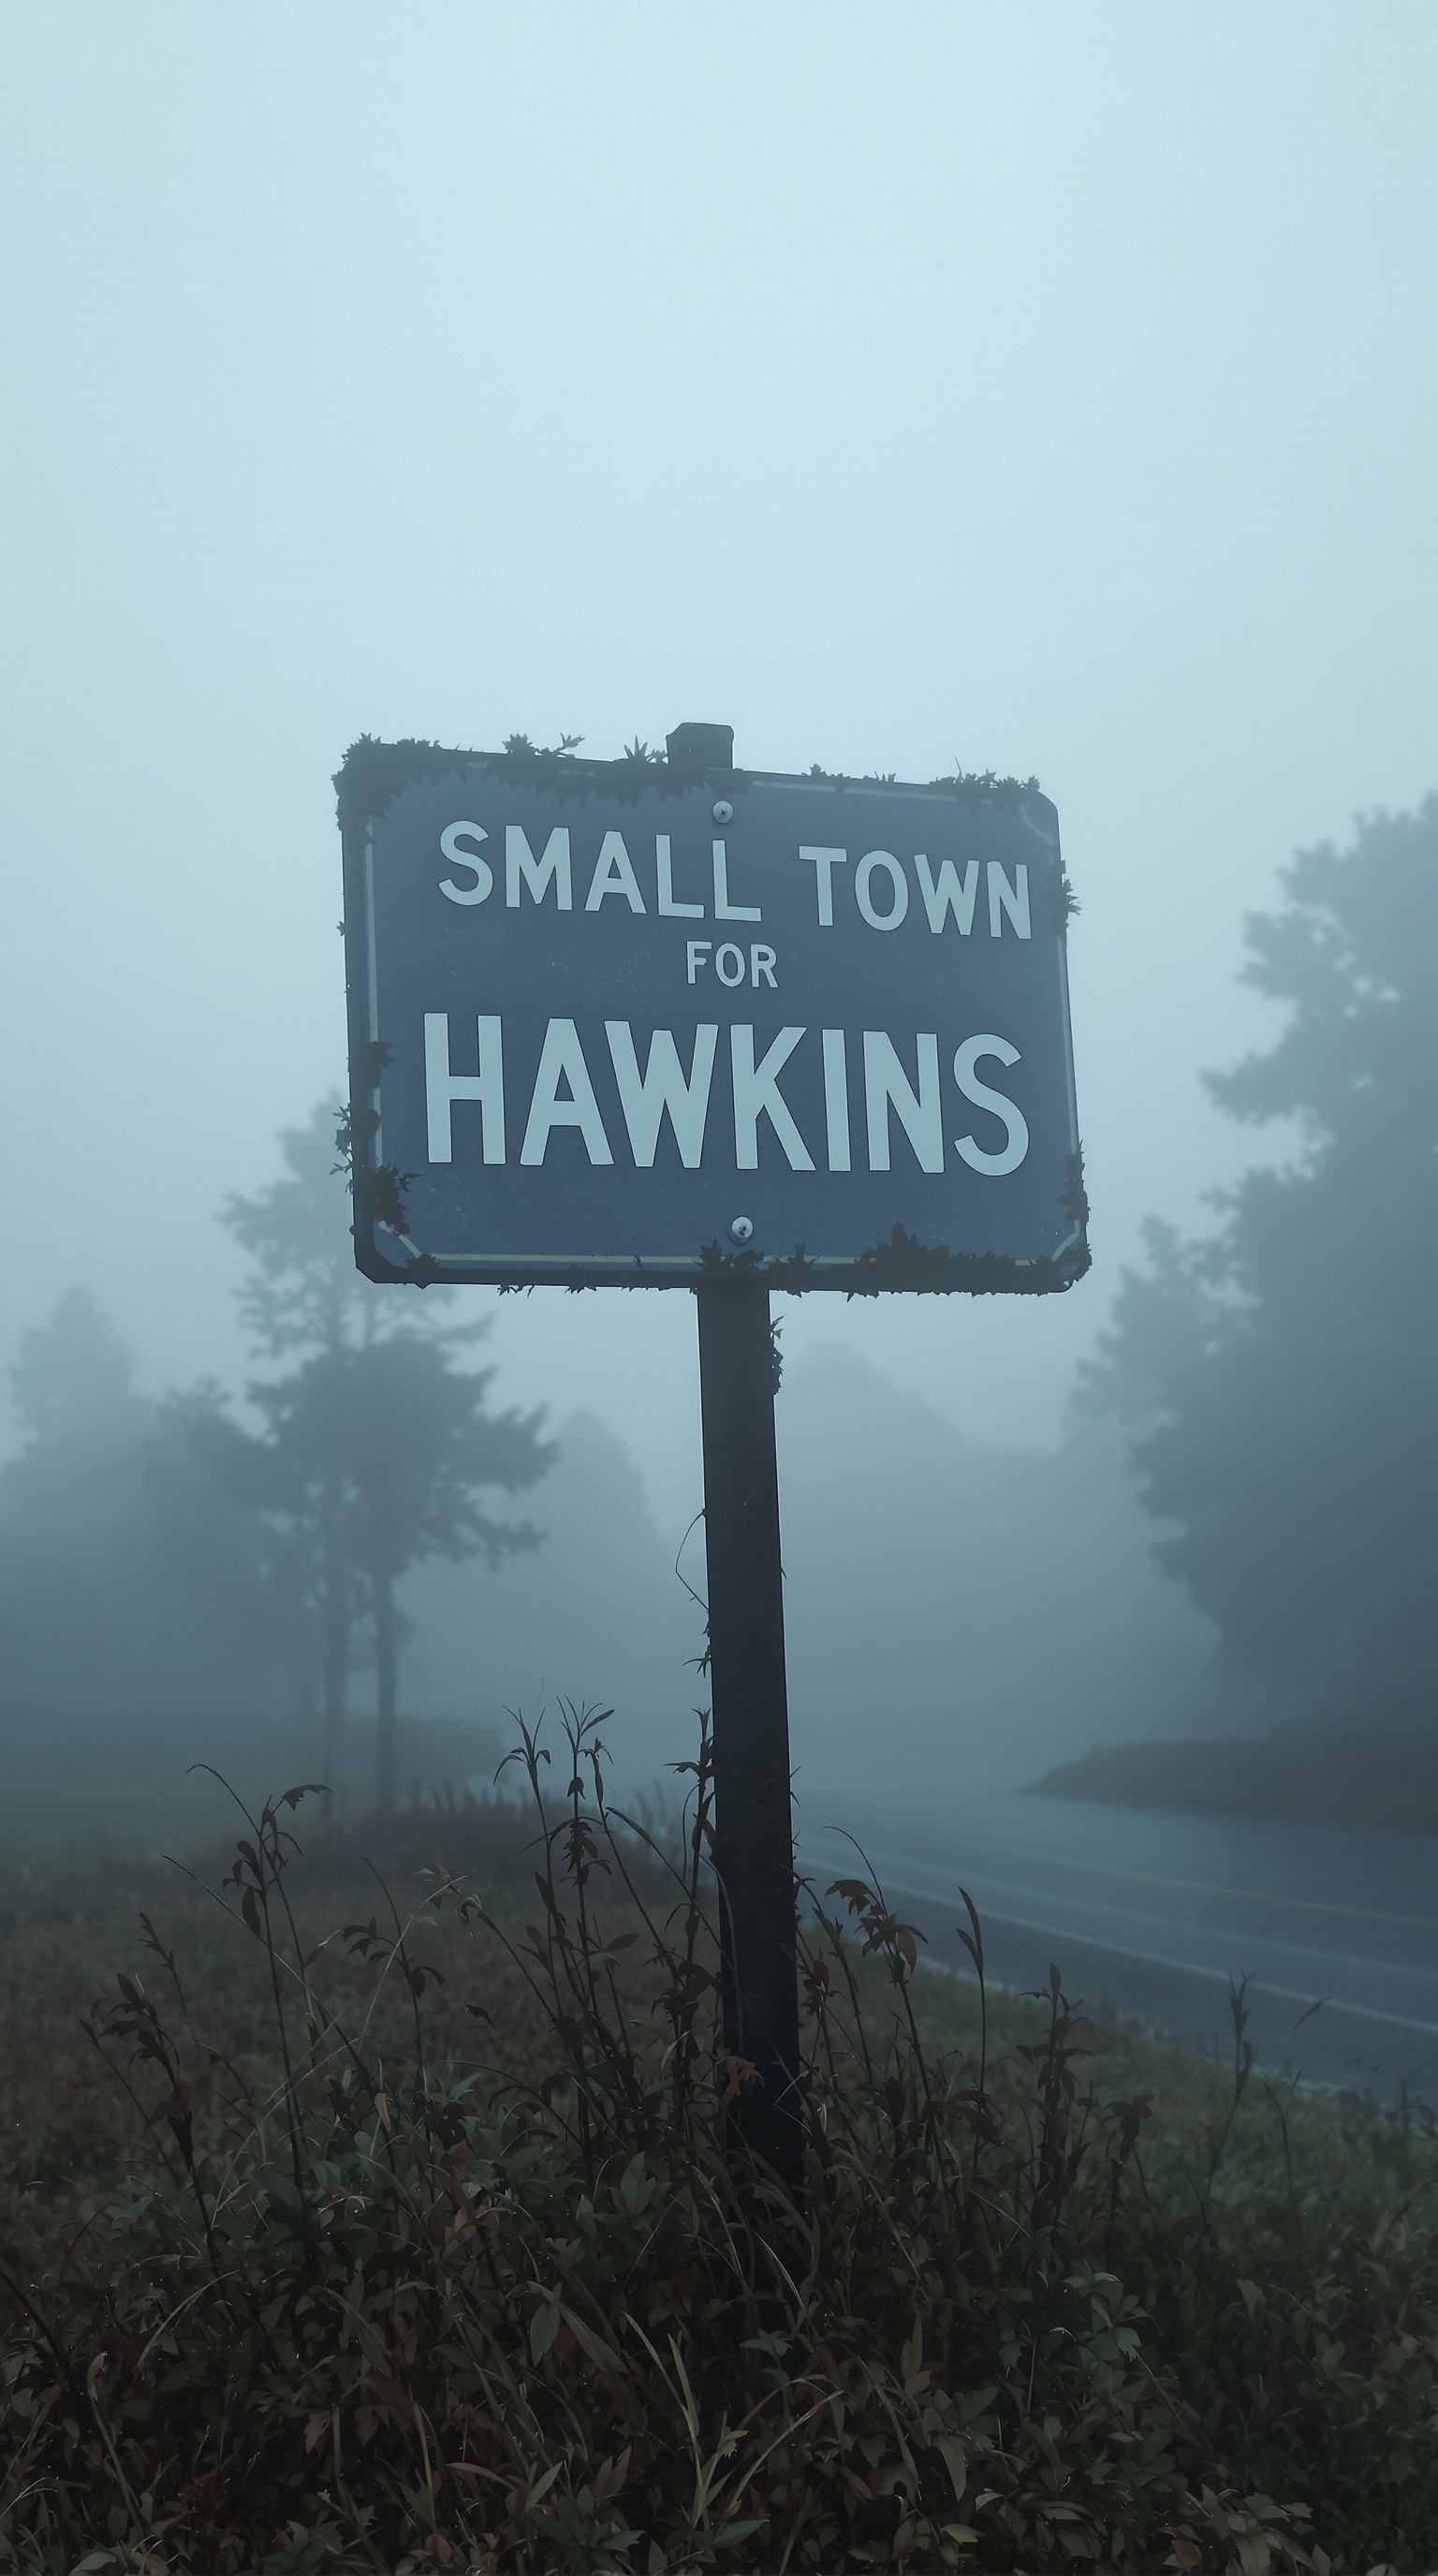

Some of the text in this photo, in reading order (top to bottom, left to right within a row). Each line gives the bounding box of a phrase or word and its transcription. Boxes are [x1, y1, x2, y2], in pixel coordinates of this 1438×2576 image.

[438, 820, 1032, 940] SMALL TOWN
[685, 941, 779, 988] FOR
[424, 1013, 1029, 1177] HAWKINS
